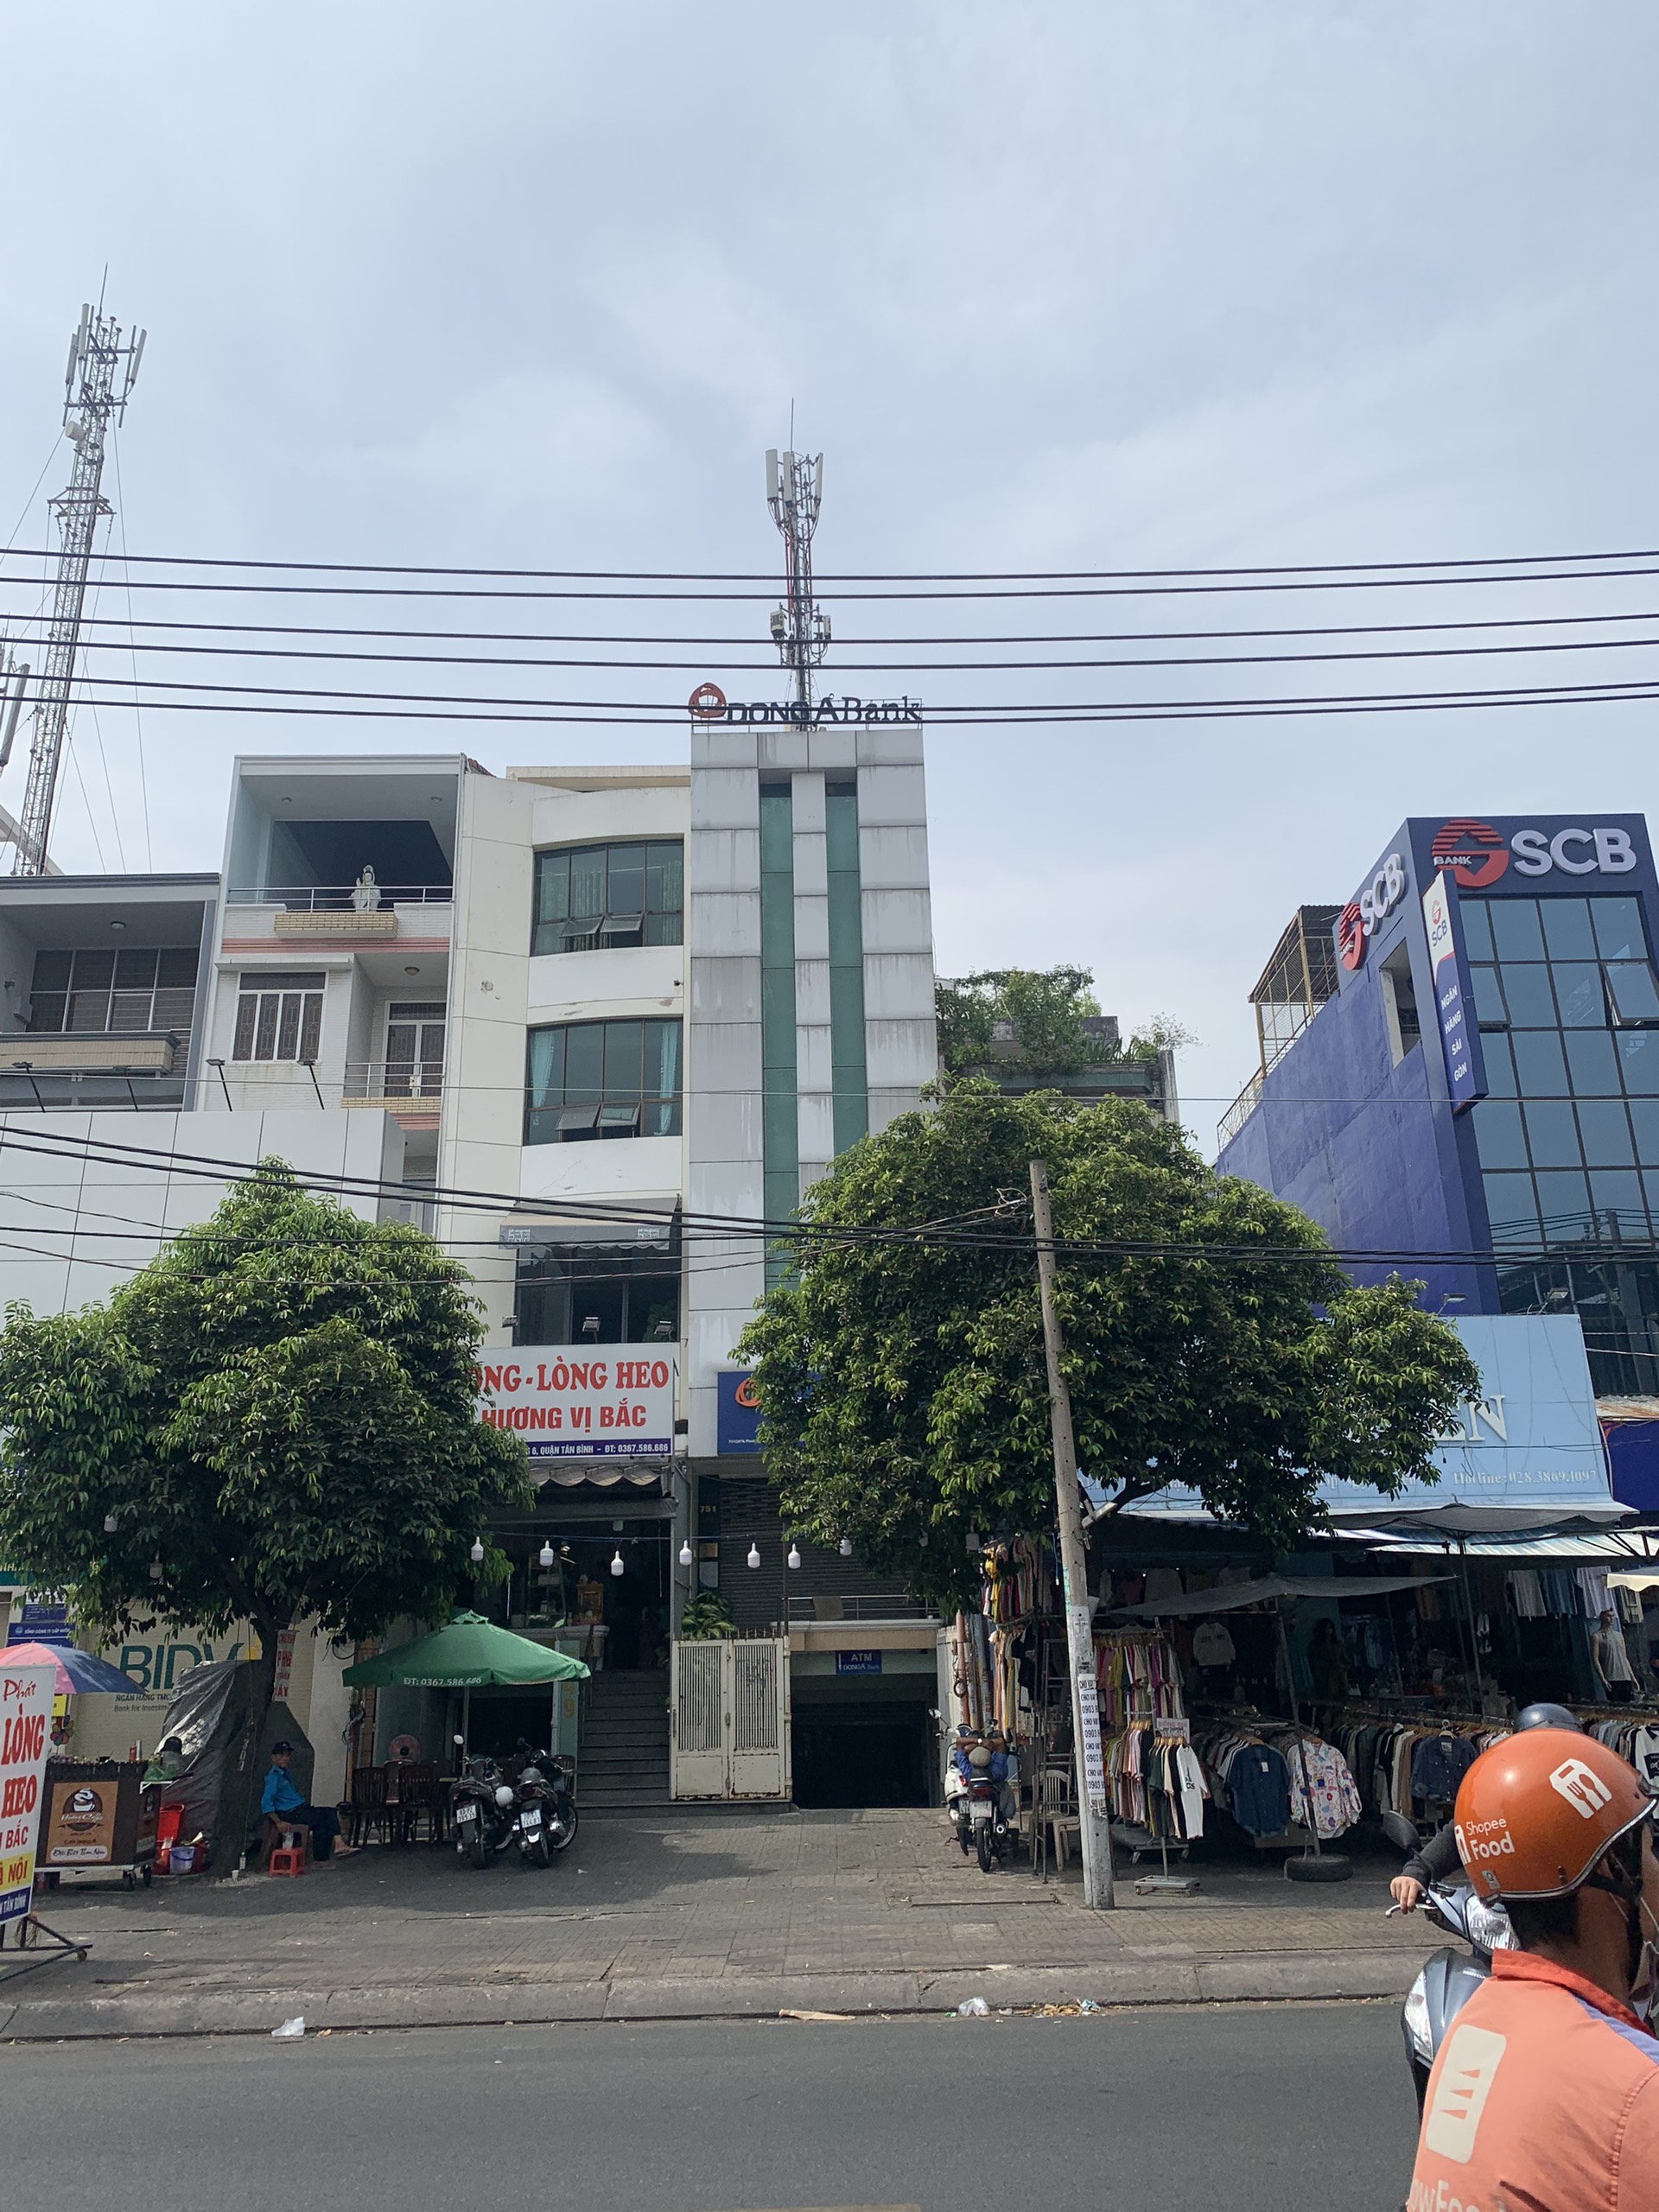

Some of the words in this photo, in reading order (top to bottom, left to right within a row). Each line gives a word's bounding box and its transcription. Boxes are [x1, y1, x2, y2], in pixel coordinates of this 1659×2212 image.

[1433, 855, 1472, 867] BANK
[1511, 827, 1637, 876] SCB
[1360, 853, 1405, 937] SCB
[1431, 918, 1448, 948] SCB
[1441, 985, 1459, 1011] NGÂN
[1445, 1009, 1462, 1035] HÀNG
[1452, 1038, 1463, 1056] SÀI
[1454, 1061, 1468, 1083] GÒN
[536, 1355, 608, 1391] LÒNG
[615, 1360, 670, 1389] HEO
[481, 1406, 563, 1431] HƯƠNG
[570, 1406, 592, 1433] VỊ
[599, 1396, 647, 1428] BẮC
[540, 1445, 560, 1457] QUẬN
[560, 1443, 575, 1455] TÂN
[575, 1443, 594, 1454] BÌNH
[605, 1444, 616, 1453] ĐT:
[617, 1442, 669, 1453] 0367.586.686
[850, 1652, 873, 1662] ATM
[3, 1679, 36, 1702] Phát
[403, 1677, 419, 1686] ĐT:
[1079, 1679, 1088, 1689] CHO
[1082, 1705, 1095, 1714] 0903
[1084, 1729, 1097, 1738] 0903
[1086, 1753, 1098, 1763] 0903
[1088, 1780, 1101, 1789] 0903
[2, 1775, 38, 1819] HEO
[5, 1819, 29, 1850] BẮC
[1465, 1816, 1507, 1837] Shopee
[1470, 1830, 1516, 1861] Food
[8, 1856, 29, 1885] NỘI
